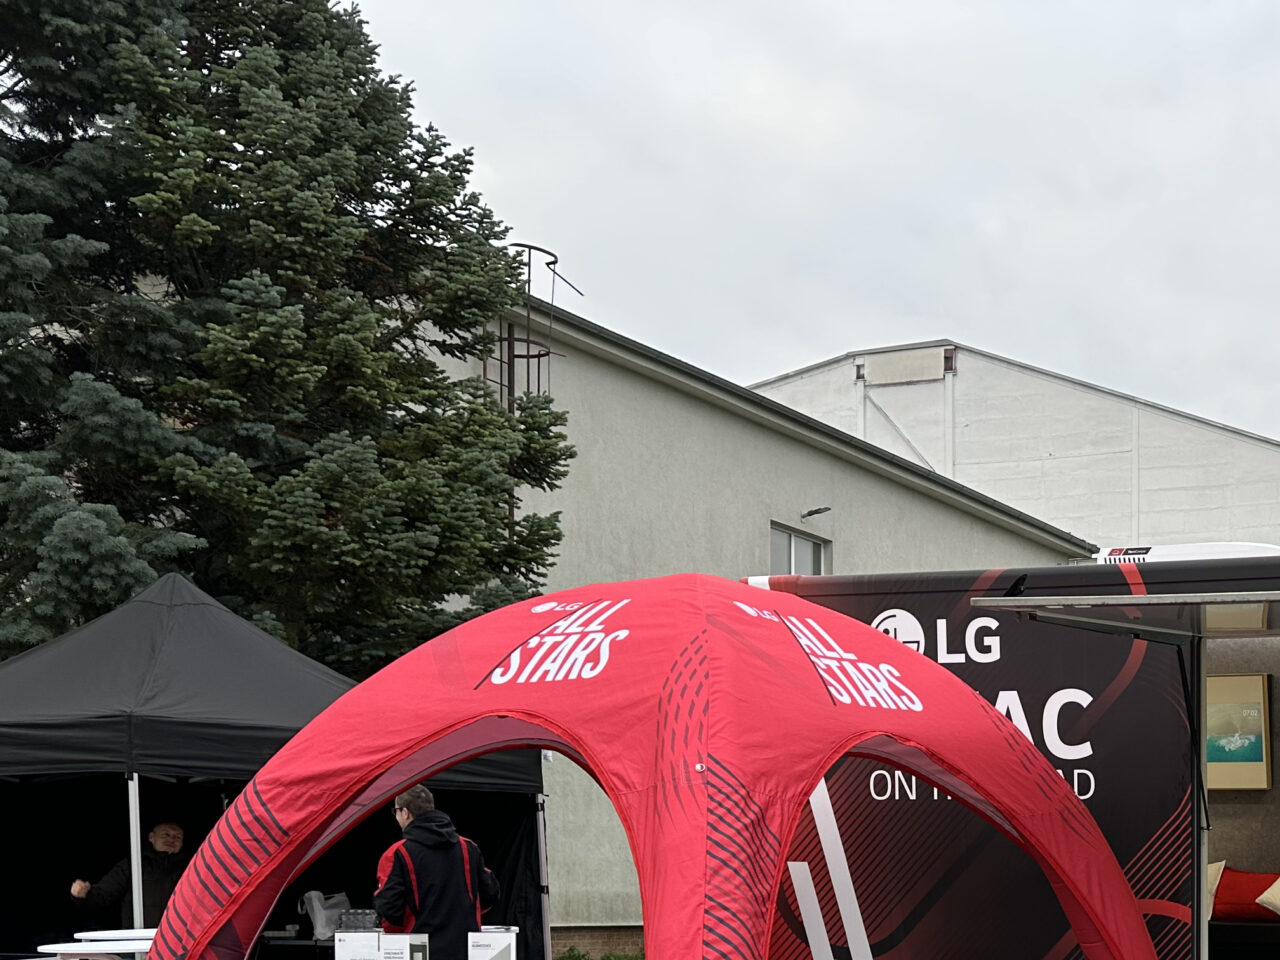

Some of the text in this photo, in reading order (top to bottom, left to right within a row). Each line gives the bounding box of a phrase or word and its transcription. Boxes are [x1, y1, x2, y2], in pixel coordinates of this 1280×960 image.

[540, 598, 632, 635] ALL
[553, 602, 584, 611] LG
[490, 629, 630, 684] STARS
[780, 615, 858, 660] ALL
[936, 616, 1001, 664] LG
[808, 654, 924, 712] STARS
[869, 769, 917, 800] ON
